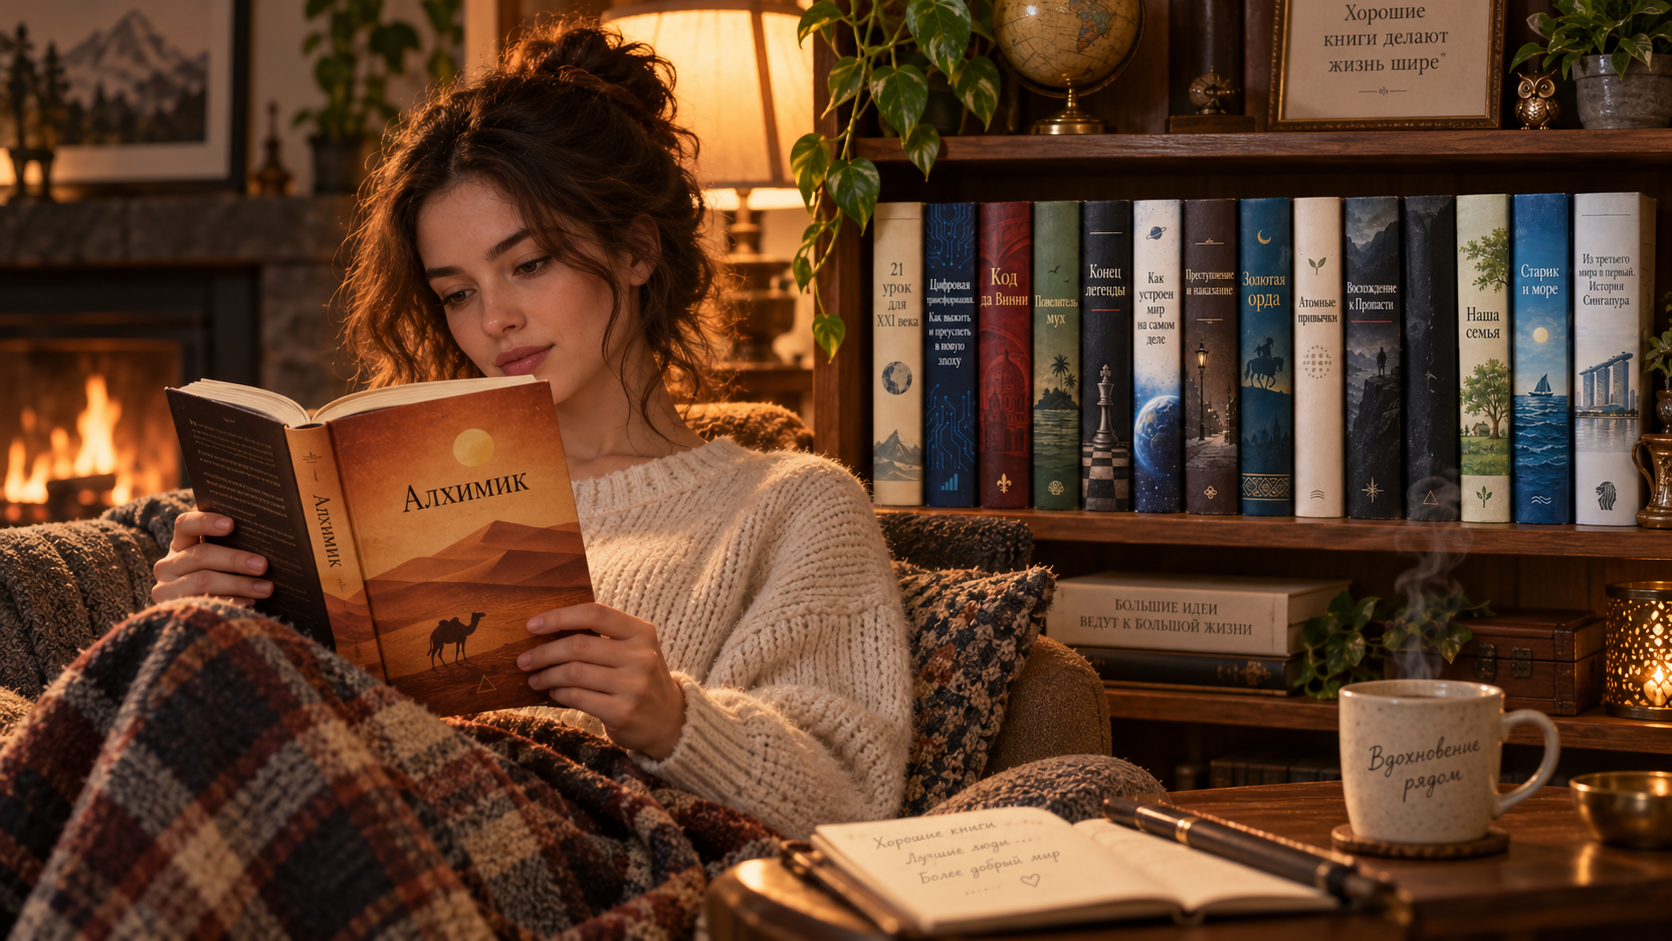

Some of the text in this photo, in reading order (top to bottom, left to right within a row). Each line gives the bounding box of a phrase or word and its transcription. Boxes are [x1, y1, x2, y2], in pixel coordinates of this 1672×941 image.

[1344, 4, 1426, 25] Хорошие
[1323, 31, 1449, 48] книги делают
[1328, 52, 1447, 75] жизнь шире"
[1582, 253, 1630, 266] Из третьего
[890, 262, 903, 276] 21
[1089, 264, 1122, 280] Конец
[1520, 263, 1560, 282] Старик
[1578, 269, 1598, 279] мира
[1599, 269, 1604, 277] в
[990, 267, 1018, 287] Код
[1147, 271, 1165, 284] Как
[1242, 271, 1286, 286] Золотая
[882, 282, 912, 297] урок
[929, 278, 971, 292] Цифровая
[1085, 285, 1126, 297] легенды
[1186, 287, 1192, 296] и
[1346, 281, 1397, 295] Восхождение
[1522, 285, 1559, 299] и море
[980, 292, 1028, 308] да Винни
[1139, 290, 1174, 303] устроен
[1248, 292, 1281, 312] орда
[1299, 296, 1336, 308] Атомные
[1582, 294, 1630, 309] Сингапура
[888, 300, 907, 311] для
[1146, 304, 1166, 318] мир
[1349, 298, 1394, 313] к Пропасти
[929, 311, 972, 323] Как выжить
[1046, 313, 1066, 328] мух
[1297, 313, 1338, 326] привычки
[1466, 307, 1500, 322] Наша
[898, 317, 919, 327] века
[1137, 320, 1175, 330] на самом
[929, 328, 934, 336] и
[1466, 328, 1500, 339] семья
[935, 342, 940, 351] в
[1146, 335, 1166, 346] деле
[937, 355, 962, 368] эпоху
[1115, 599, 1218, 616] БОЛЬШИЕ ИДЕИ
[1080, 615, 1253, 636] ВЕДУТ К БОЛЬШОЙ ЖИЗНИ
[1368, 736, 1481, 778] Вдохновение
[1402, 770, 1463, 803] рядом
[872, 819, 998, 851] Хорошие книги
[904, 847, 965, 867] Лучшие
[970, 837, 1010, 853] люди
[919, 850, 1061, 885] Более добрый мир
